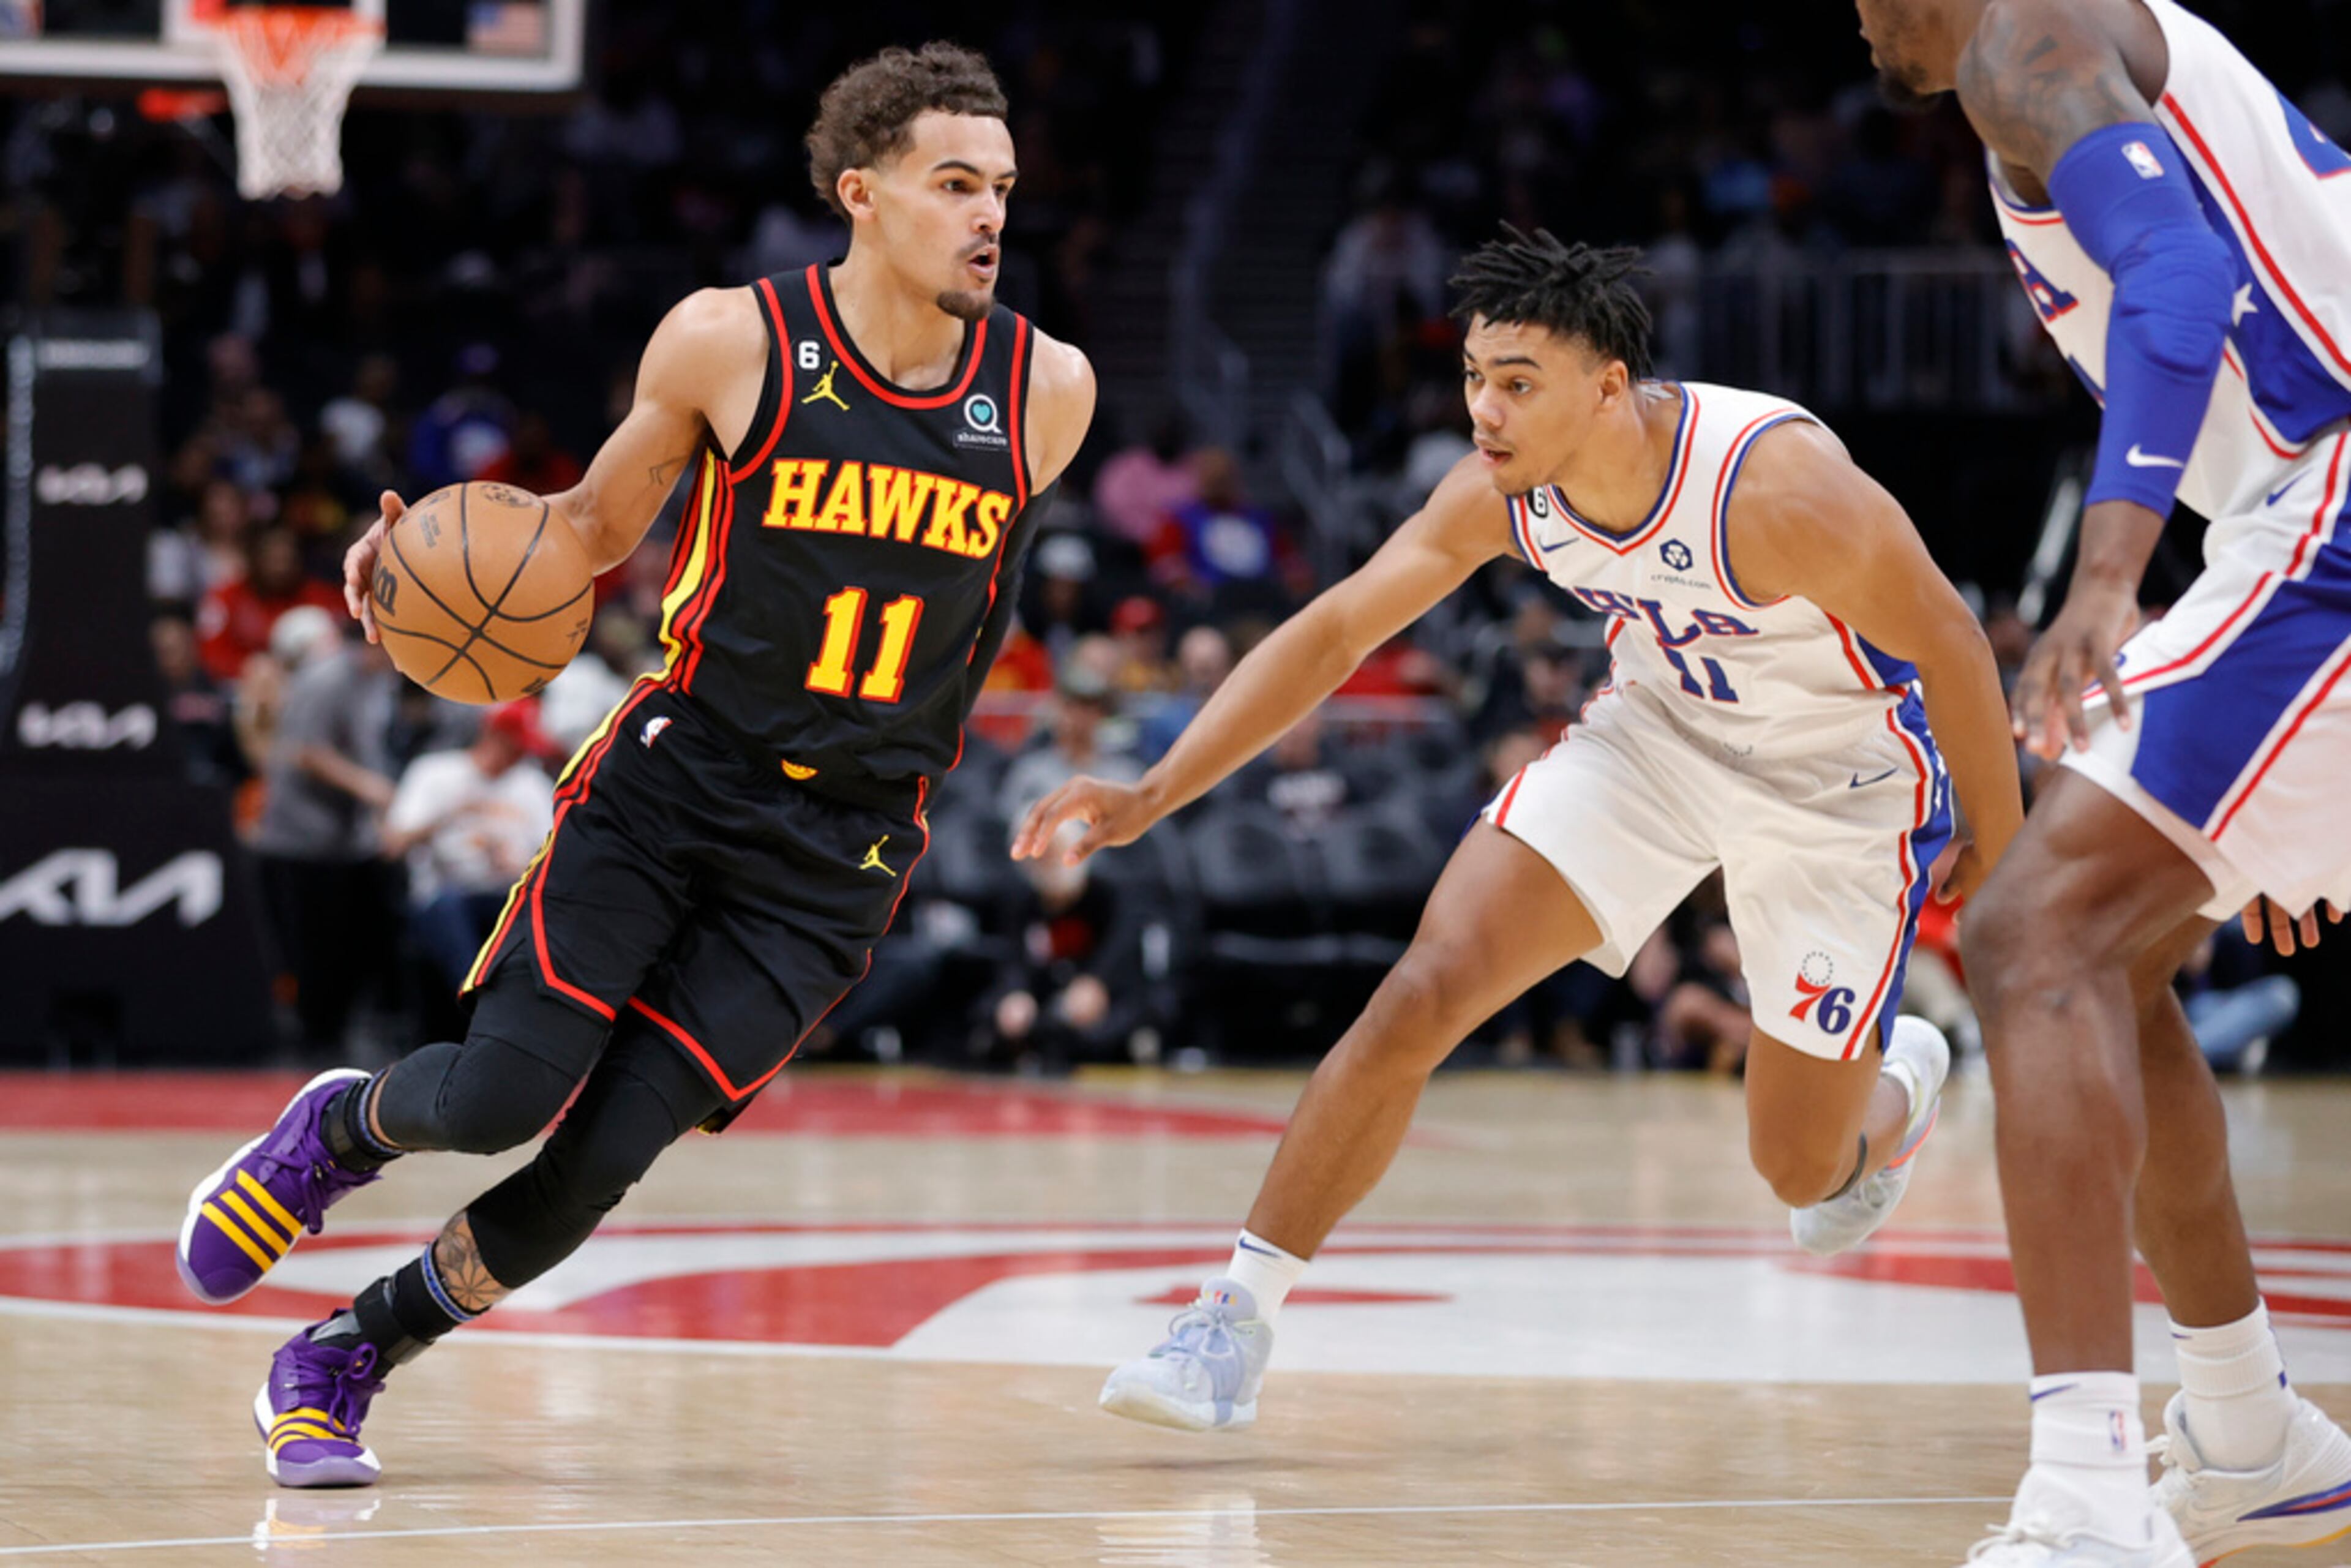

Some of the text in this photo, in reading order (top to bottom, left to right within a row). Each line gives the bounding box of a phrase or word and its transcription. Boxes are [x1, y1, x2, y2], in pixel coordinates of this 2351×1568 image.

[798, 340, 820, 369] 6
[762, 458, 1014, 560] HAWKS
[1533, 486, 1547, 514] 6
[804, 585, 924, 704] 11
[1662, 647, 1739, 704] 11
[1789, 972, 1856, 1035] 76
